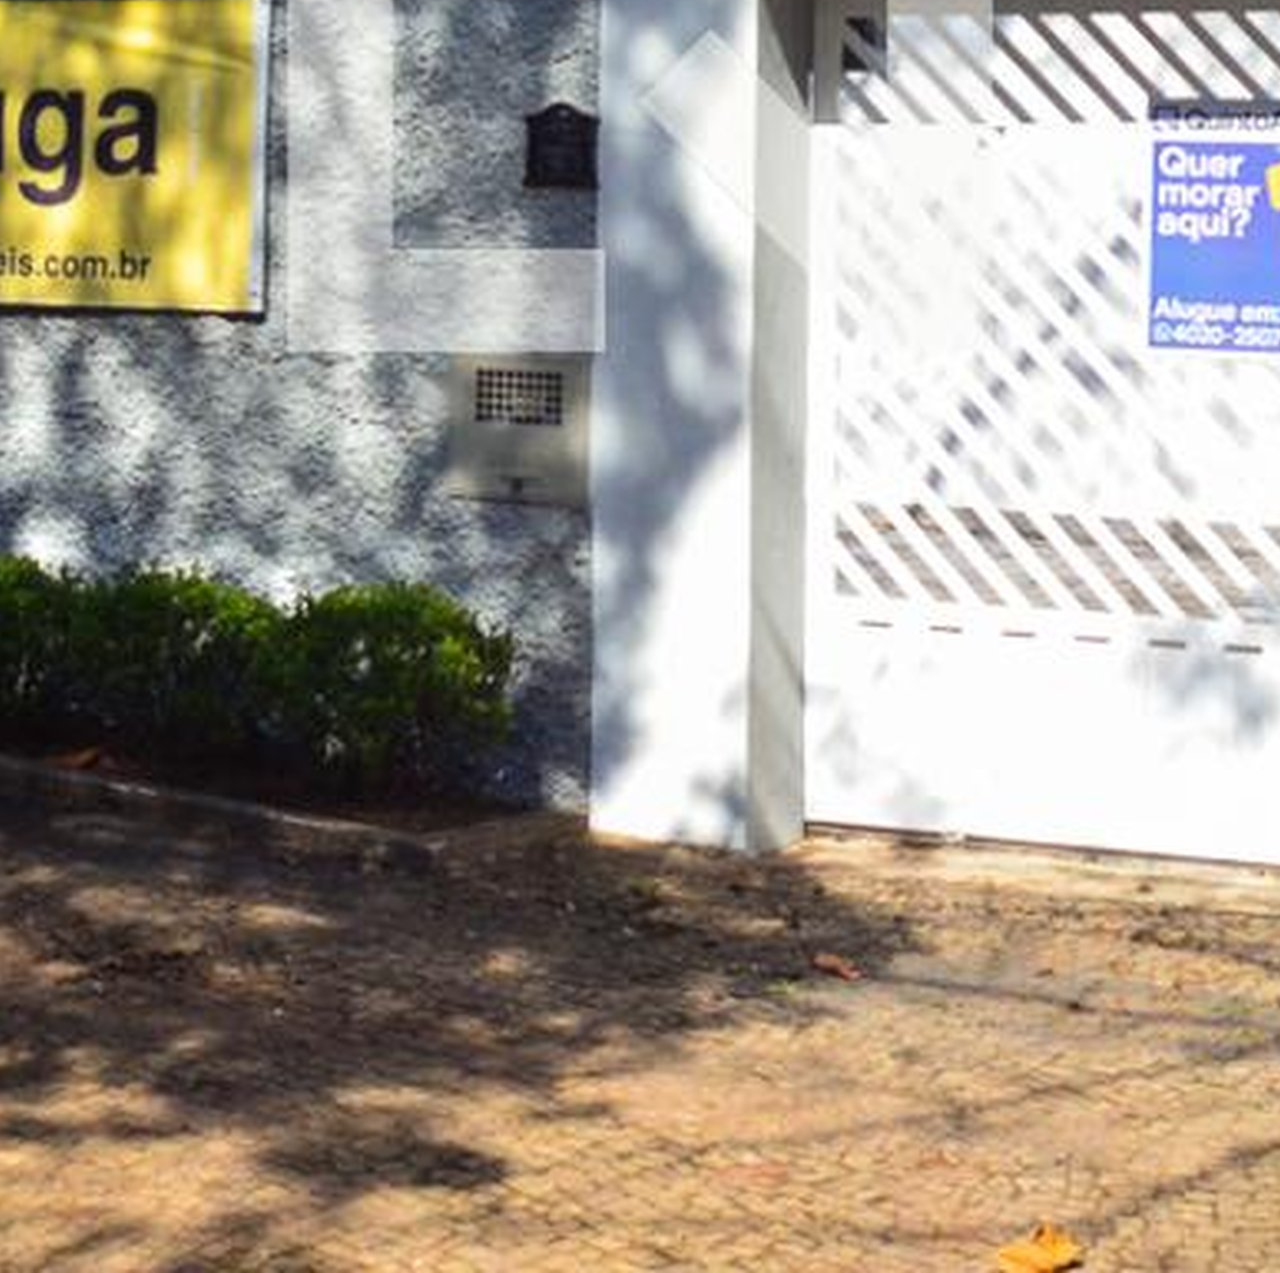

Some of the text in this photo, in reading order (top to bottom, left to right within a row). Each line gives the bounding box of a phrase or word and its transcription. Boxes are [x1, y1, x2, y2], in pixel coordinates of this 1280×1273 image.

[1156, 146, 1245, 177] Quer
[1157, 182, 1261, 208] morar
[1157, 208, 1252, 242] aqui?
[1153, 297, 1237, 323] Alugue
